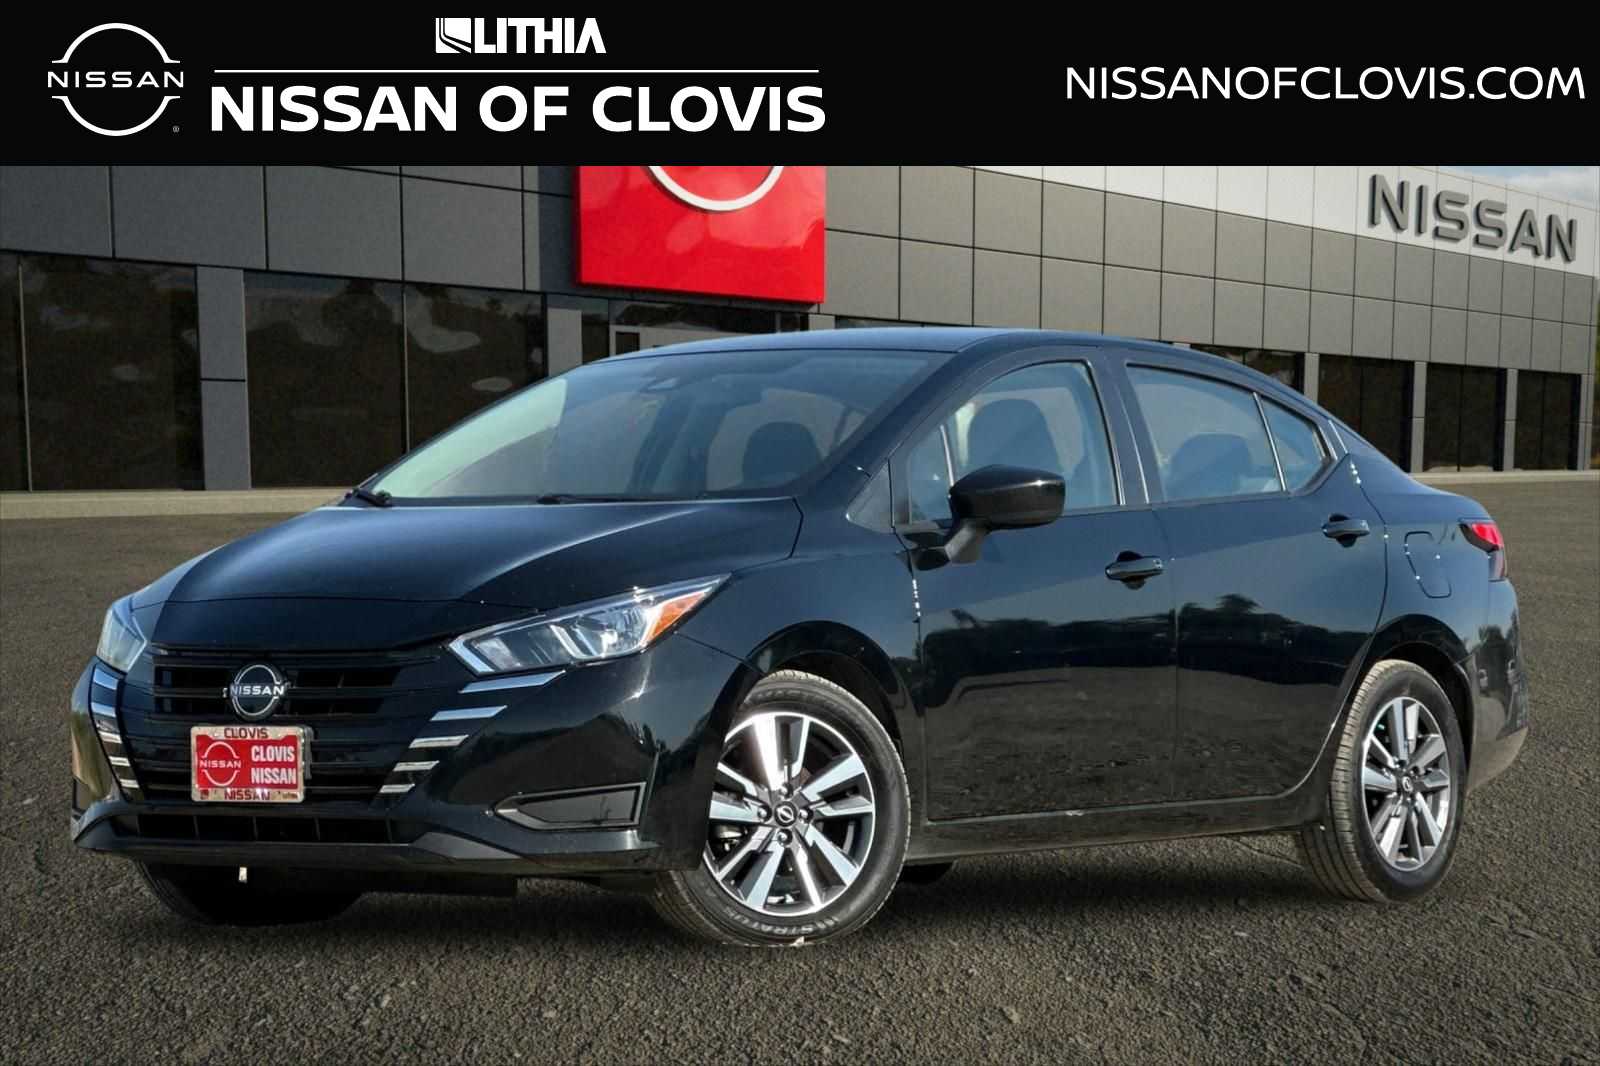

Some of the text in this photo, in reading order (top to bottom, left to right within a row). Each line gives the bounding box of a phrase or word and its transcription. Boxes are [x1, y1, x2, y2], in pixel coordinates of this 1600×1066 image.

[1368, 174, 1577, 263] NISSAN
[230, 685, 285, 696] NISSAN
[224, 727, 268, 739] CLOVIS
[251, 745, 295, 762] CLOVIS
[200, 760, 241, 768] NISSAN
[251, 767, 297, 784] NISSAN
[224, 789, 270, 800] NISSAN
